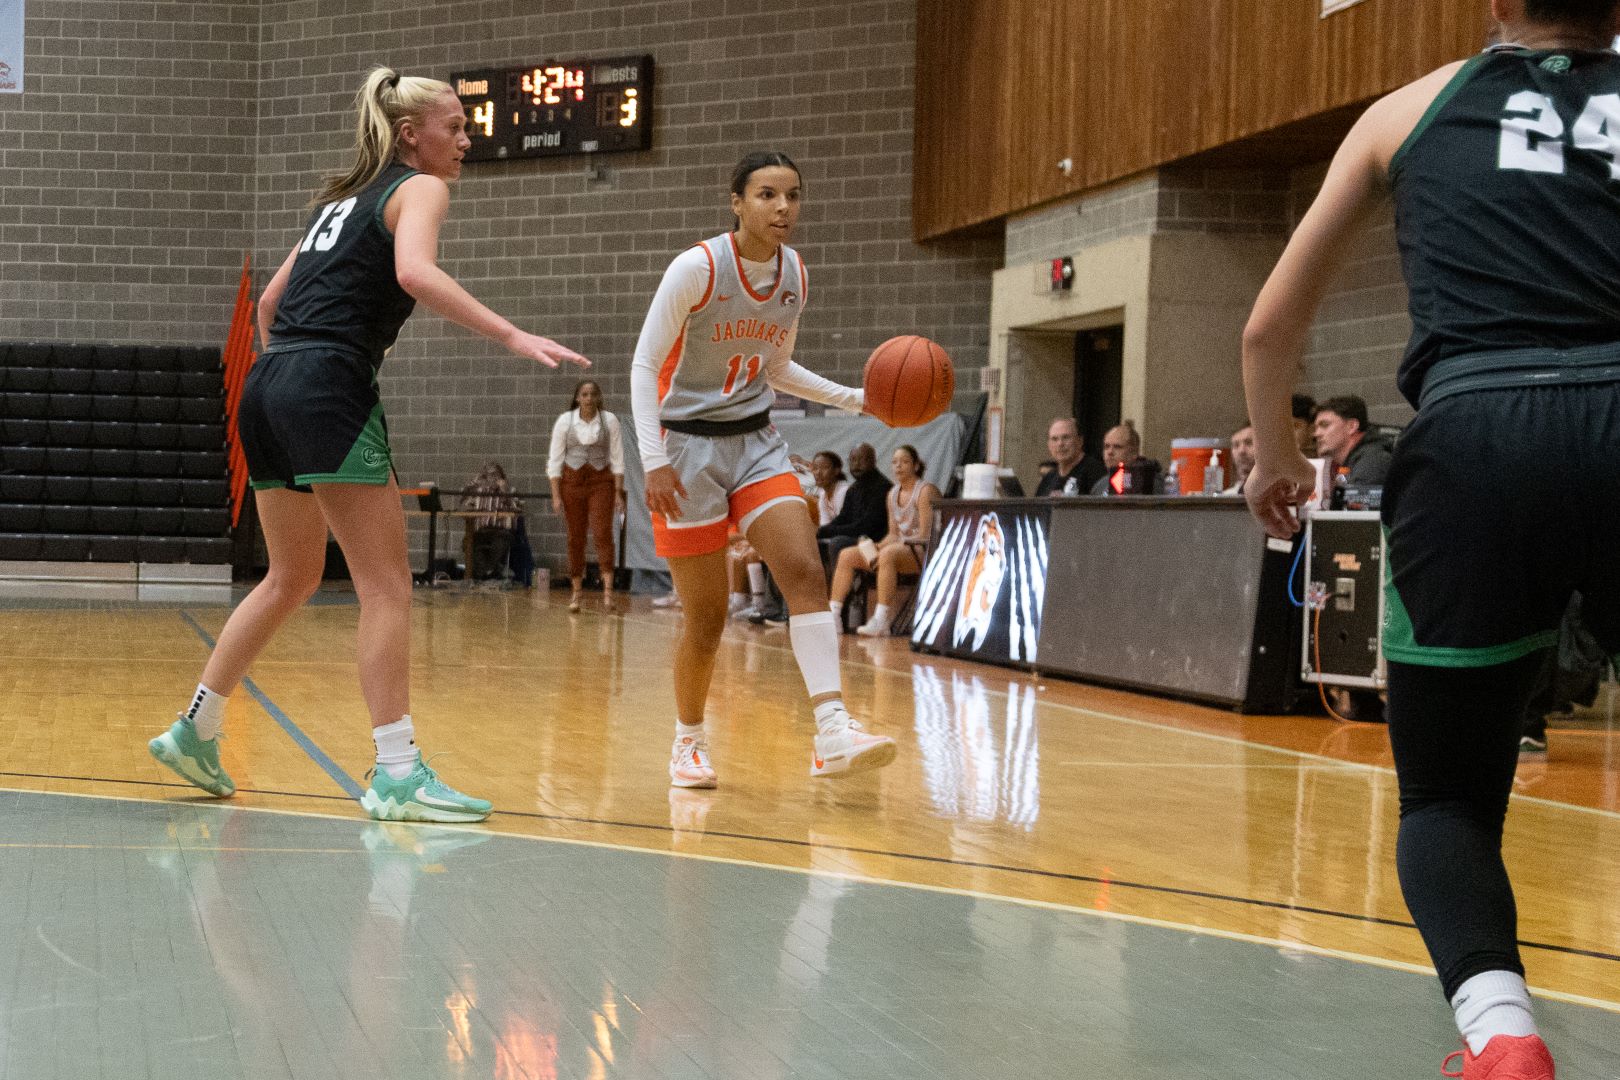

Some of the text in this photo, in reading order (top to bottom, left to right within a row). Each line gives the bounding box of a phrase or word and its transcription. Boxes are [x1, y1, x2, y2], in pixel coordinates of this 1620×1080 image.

[458, 79, 488, 95] Home
[474, 101, 494, 136] 4
[1499, 90, 1620, 180] 24
[523, 131, 560, 151] period
[300, 196, 358, 253] 13
[711, 319, 788, 348] JAGUARS
[721, 353, 762, 397] 11
